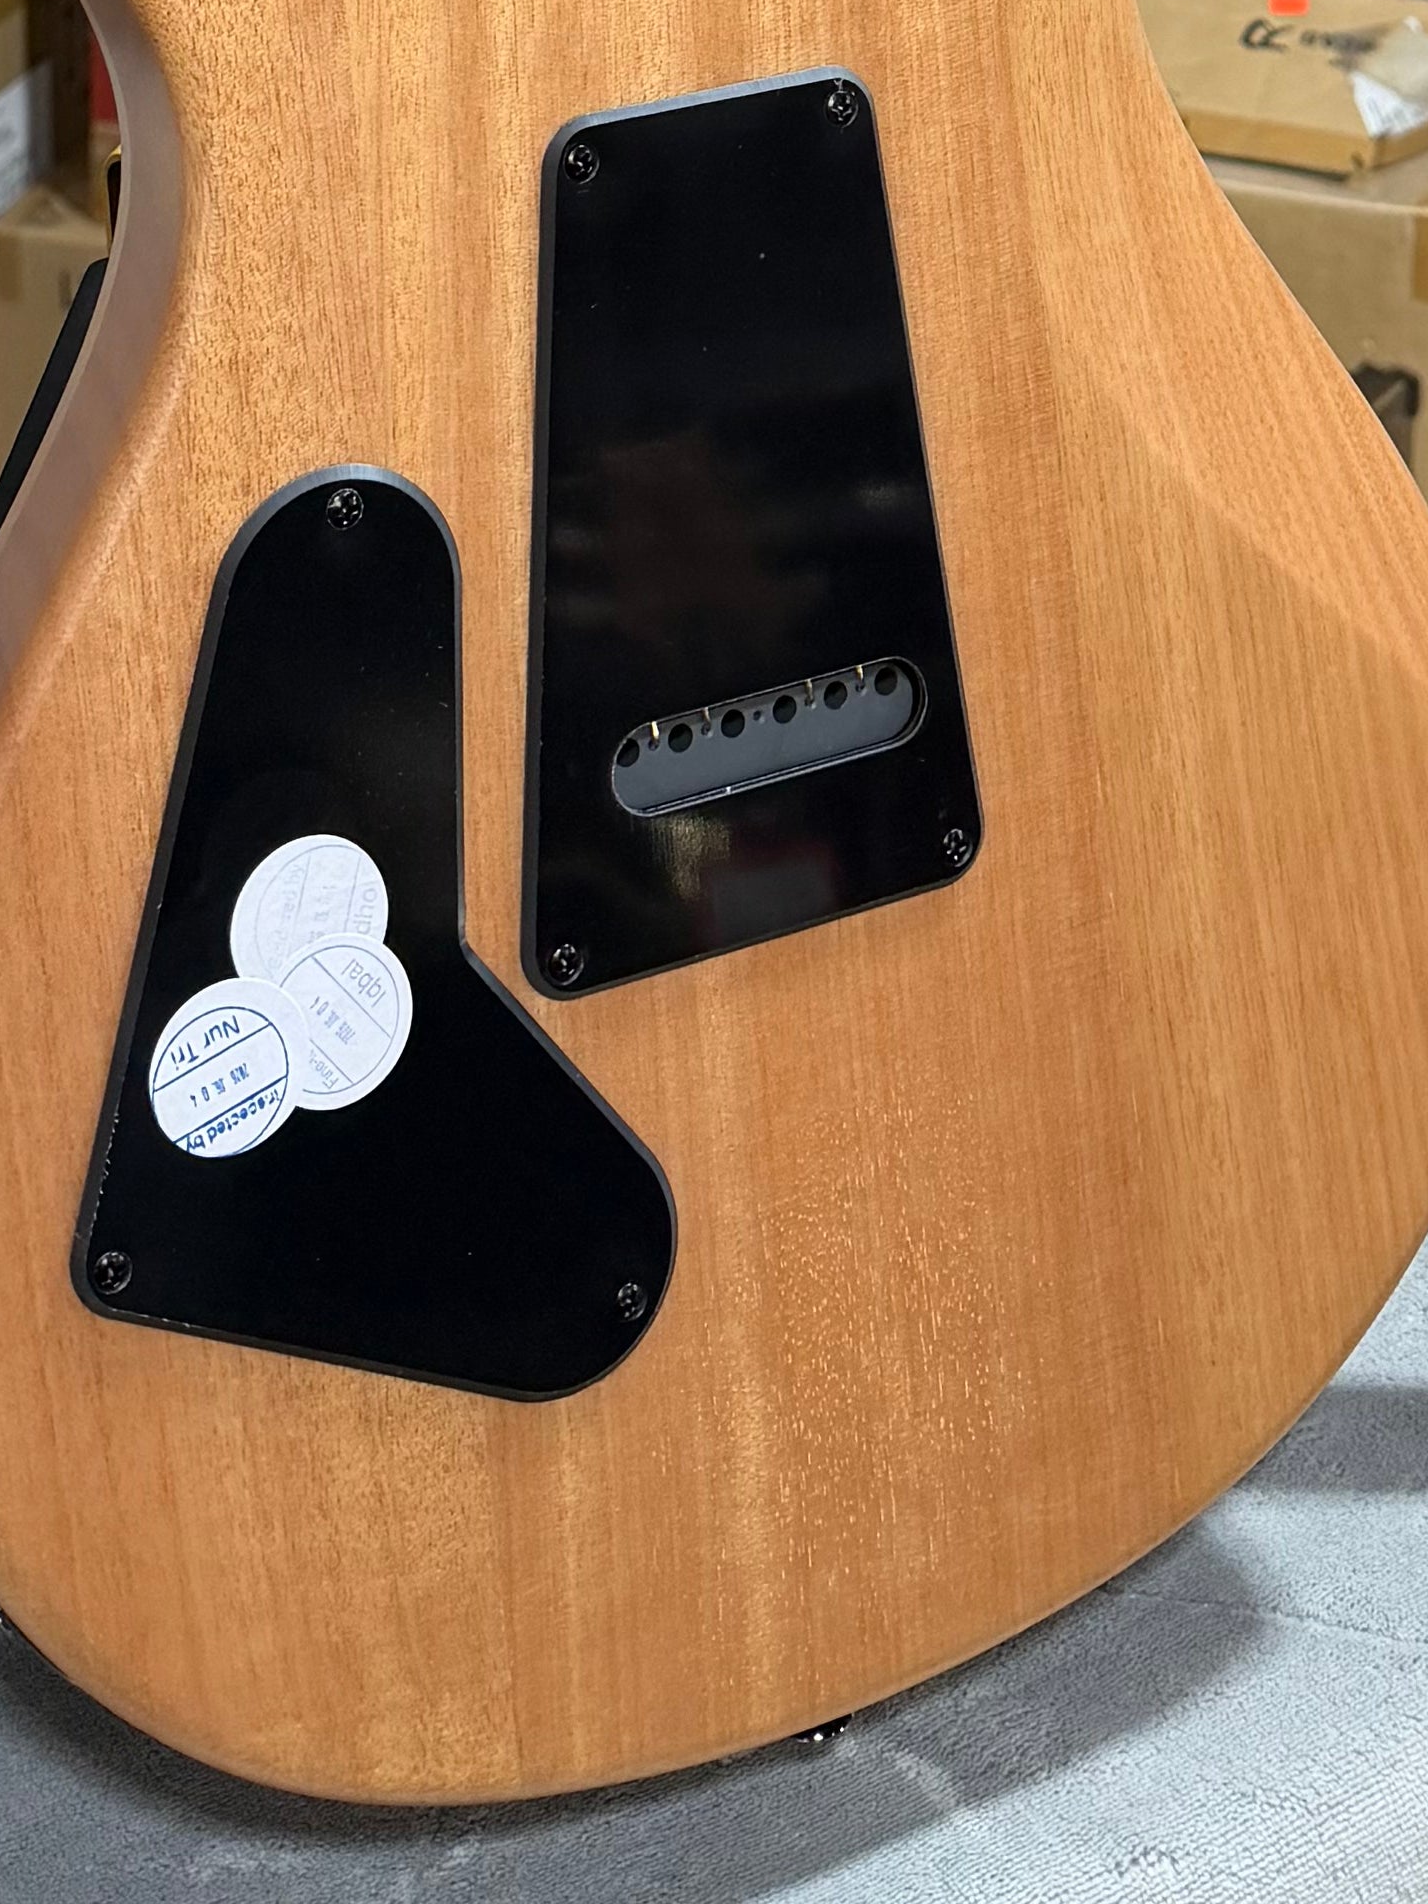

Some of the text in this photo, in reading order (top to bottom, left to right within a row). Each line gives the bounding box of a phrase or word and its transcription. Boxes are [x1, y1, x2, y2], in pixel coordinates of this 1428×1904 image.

[170, 1014, 241, 1071] Nur Tri
[185, 1133, 206, 1153] by
